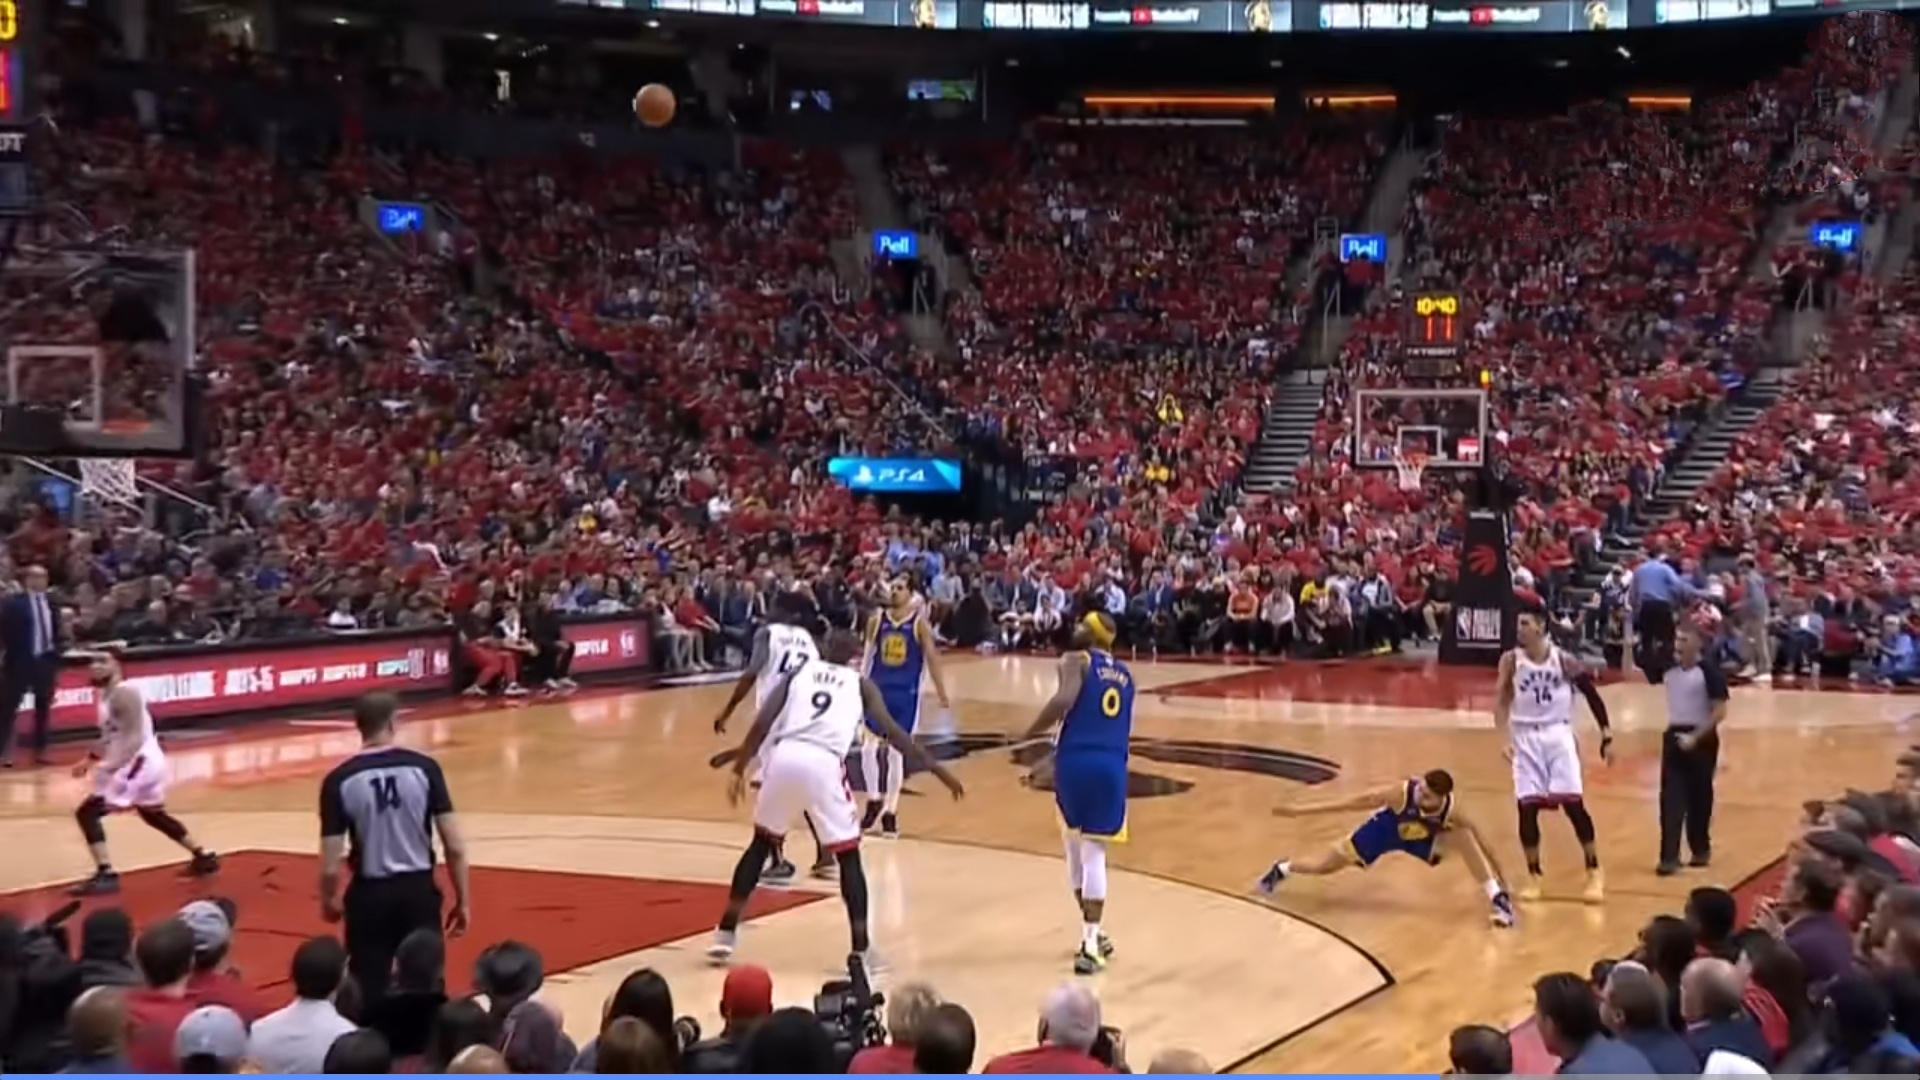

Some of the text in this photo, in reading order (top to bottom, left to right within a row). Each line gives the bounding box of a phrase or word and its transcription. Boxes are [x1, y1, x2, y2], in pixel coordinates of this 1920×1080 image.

[880, 235, 909, 254] Bell
[1417, 297, 1456, 315] 10:40
[1427, 315, 1452, 340] 11
[879, 468, 924, 482] PS4
[811, 691, 833, 720] 9
[1102, 687, 1121, 717] 0
[1534, 686, 1553, 704] 14
[369, 776, 402, 815] 14
